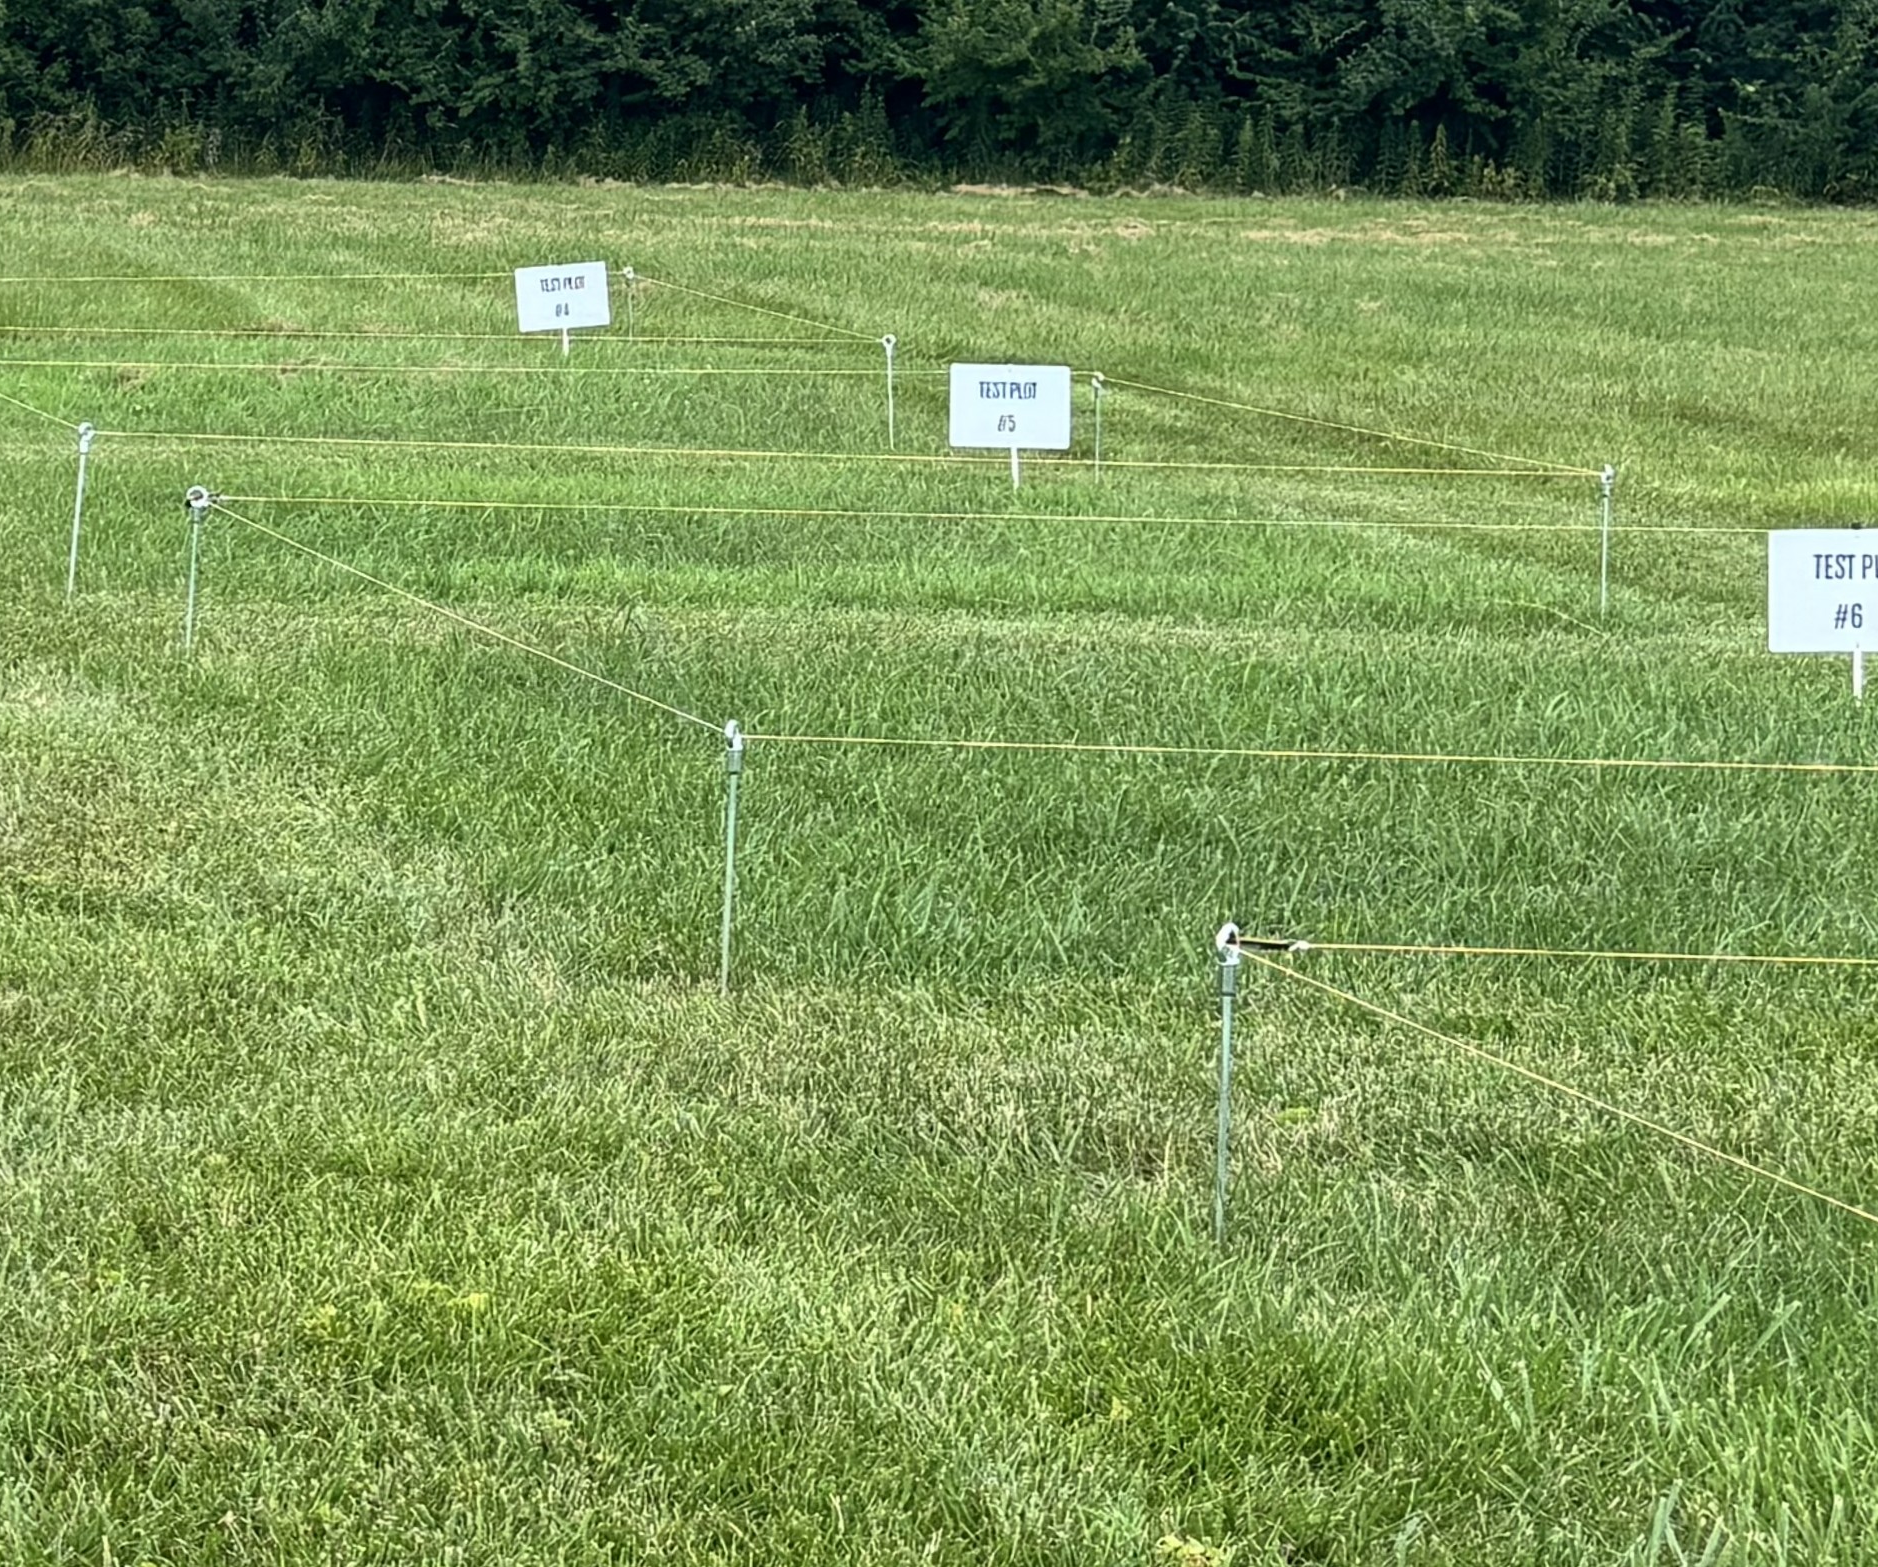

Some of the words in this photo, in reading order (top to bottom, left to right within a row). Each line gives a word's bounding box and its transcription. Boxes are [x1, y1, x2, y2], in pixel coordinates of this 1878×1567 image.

[979, 381, 1007, 399] TEST
[1009, 382, 1037, 400] PLOT
[997, 414, 1016, 432] #5
[1813, 554, 1856, 580] TEST
[1834, 602, 1863, 630] #6
